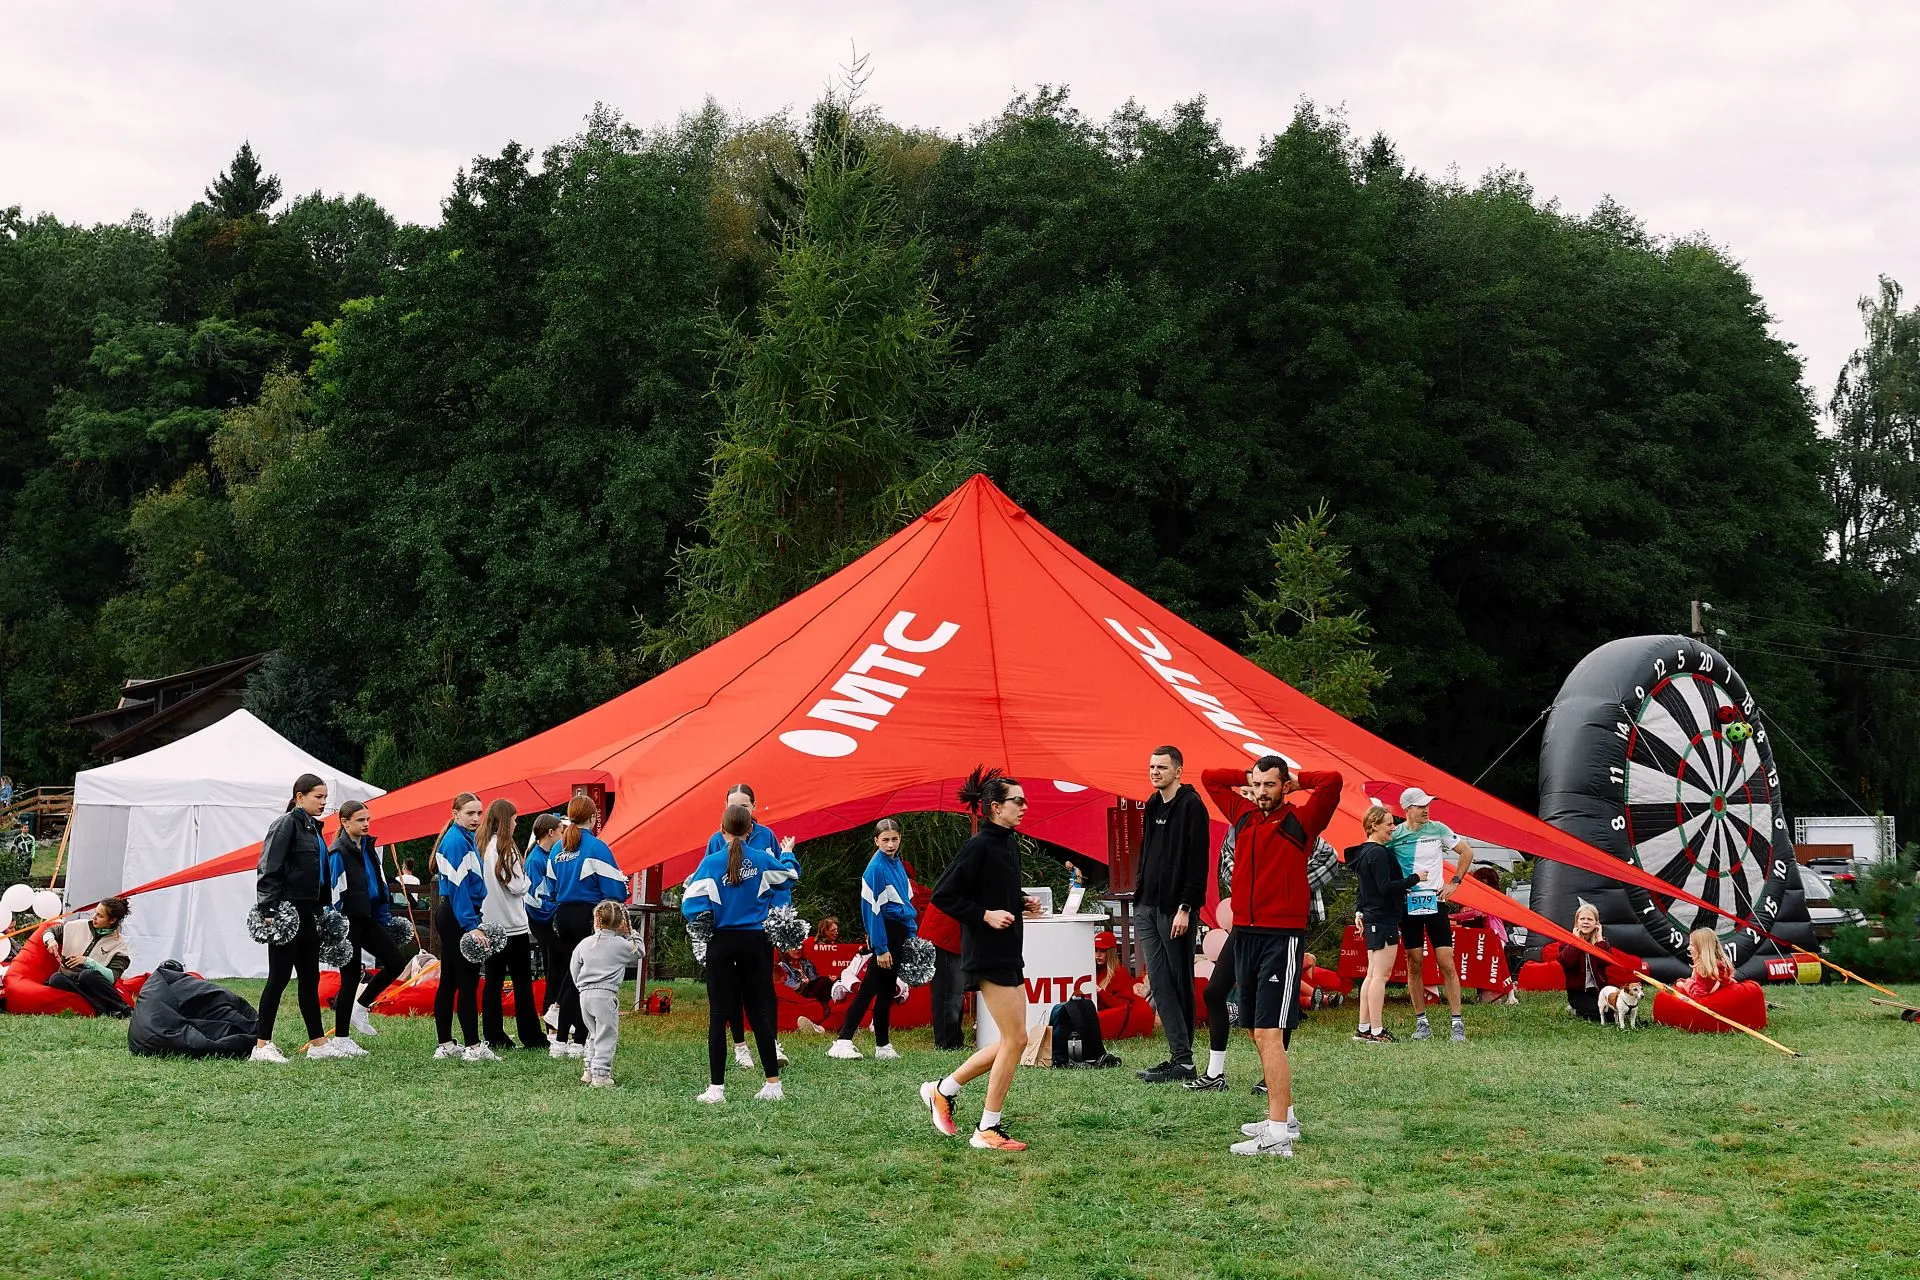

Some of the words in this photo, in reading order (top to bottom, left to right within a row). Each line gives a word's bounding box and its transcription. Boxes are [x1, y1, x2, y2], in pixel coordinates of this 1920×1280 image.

[1653, 658, 1667, 680] 12
[1677, 650, 1686, 670] 5
[1699, 651, 1714, 672] 20
[806, 610, 961, 732] МТС
[1103, 617, 1264, 741] МТС
[1725, 667, 1732, 684] 1
[1634, 685, 1645, 702] 9
[1741, 691, 1755, 716] 18
[1614, 722, 1630, 741] 14
[1756, 730, 1766, 744] 4
[1609, 766, 1624, 784] 11
[1767, 767, 1779, 788] 13
[1611, 815, 1626, 831] 8
[1774, 817, 1787, 830] 6
[1773, 859, 1787, 879] 10
[1411, 895, 1433, 905] 5179
[1643, 899, 1656, 915] 7
[1764, 896, 1778, 918] 15
[1477, 933, 1485, 955] МТС
[1670, 927, 1684, 949] 19
[1746, 927, 1761, 945] 2
[1461, 952, 1469, 975] МТС
[1490, 956, 1499, 977] МТС
